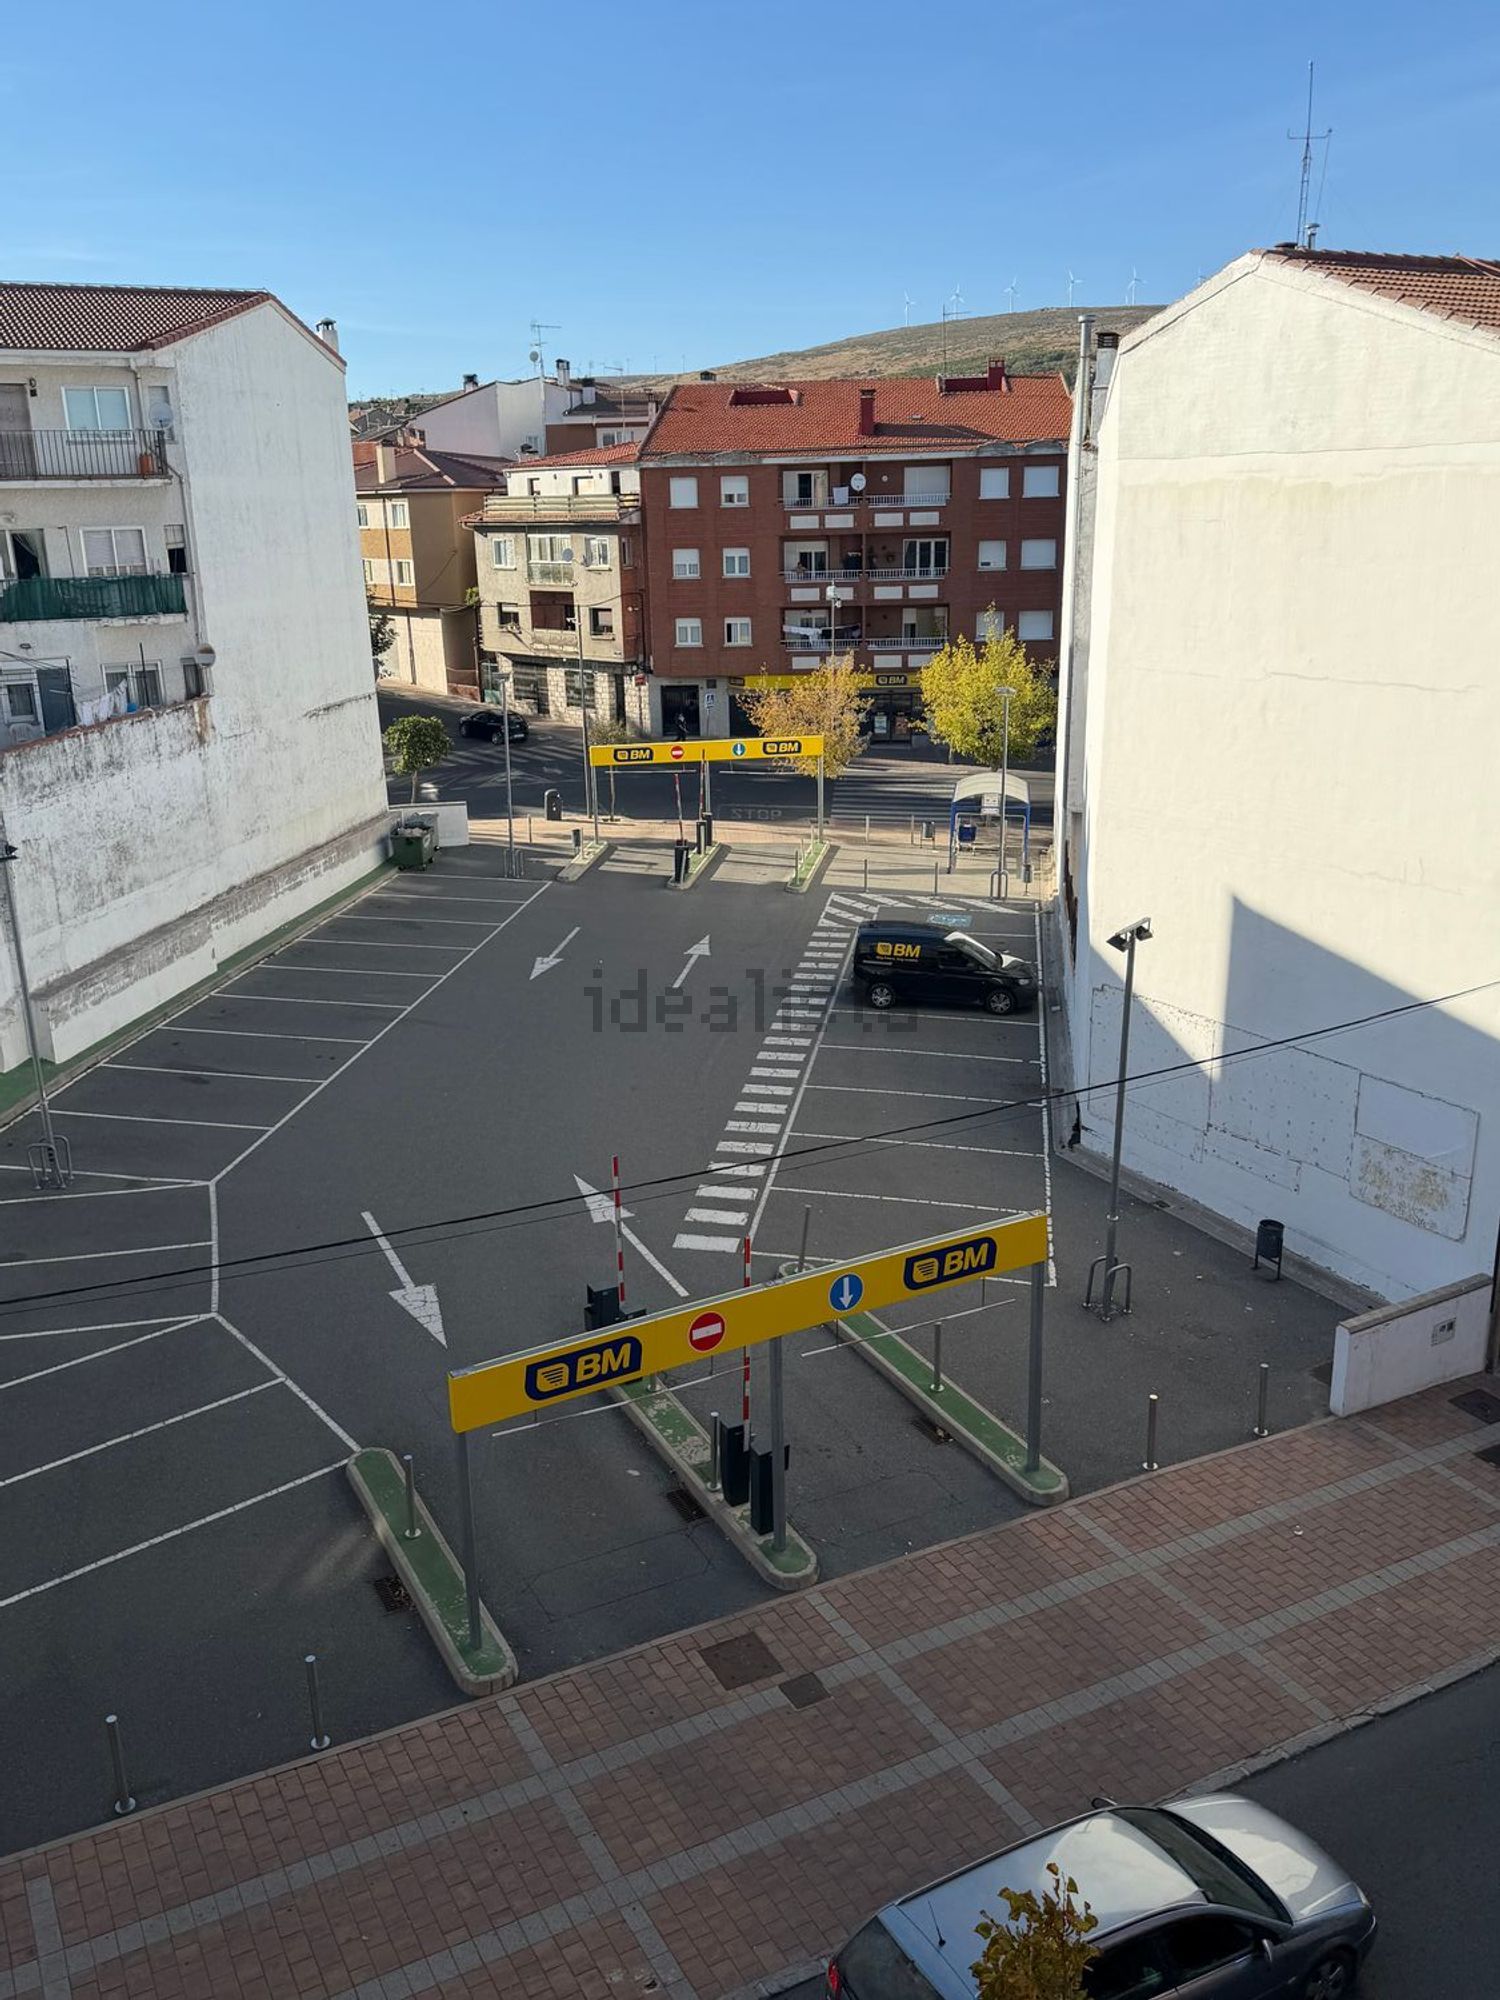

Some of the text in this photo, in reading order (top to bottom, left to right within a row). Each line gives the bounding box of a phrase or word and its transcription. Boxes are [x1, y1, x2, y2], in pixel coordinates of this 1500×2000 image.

[889, 675, 905, 684] BM
[778, 742, 799, 752] BM
[630, 749, 650, 760] BM
[731, 808, 782, 820] STOP
[893, 943, 921, 958] BM
[943, 1243, 989, 1276] BM
[575, 1342, 631, 1383] BM
